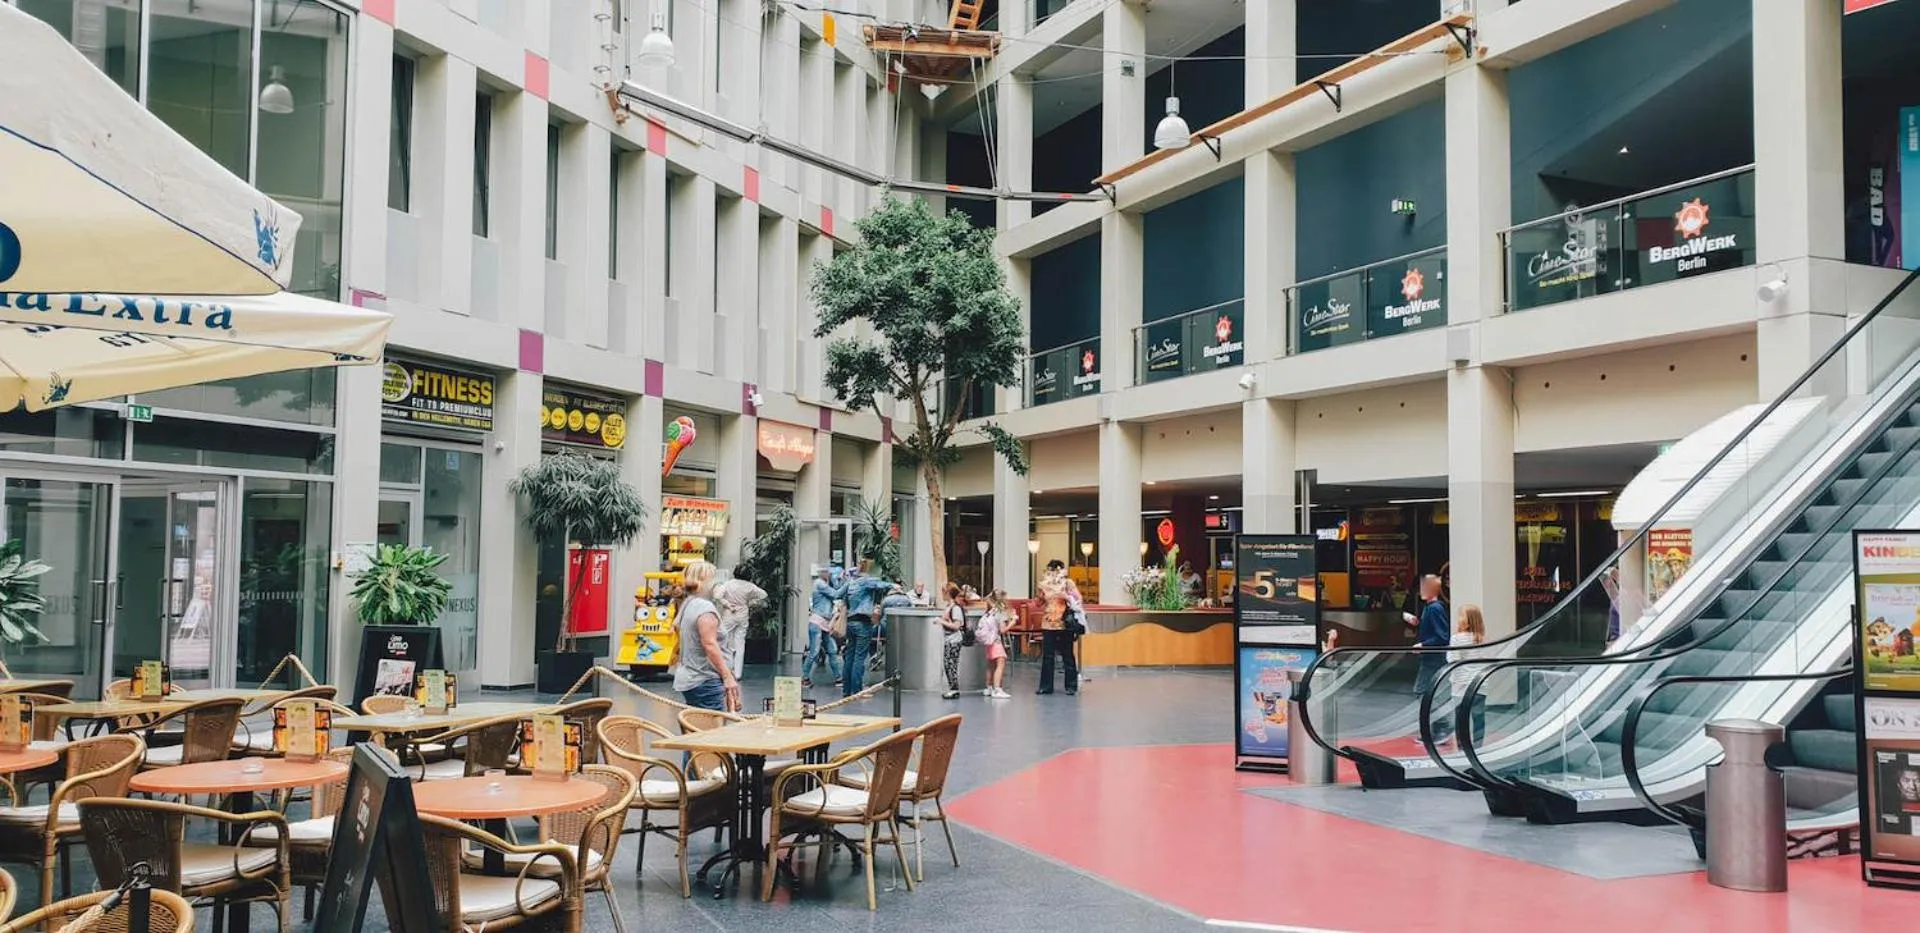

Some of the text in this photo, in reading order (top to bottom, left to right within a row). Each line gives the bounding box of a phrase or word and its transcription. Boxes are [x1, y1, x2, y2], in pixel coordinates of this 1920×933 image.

[1869, 167, 1885, 227] BAD
[1677, 256, 1707, 272] Berlin
[63, 292, 233, 331] Extra
[1402, 315, 1423, 328] Berlin
[412, 368, 492, 405] FITNESS
[412, 397, 424, 408] FIT
[1357, 555, 1382, 564] HAPPY
[1254, 571, 1276, 599] 5
